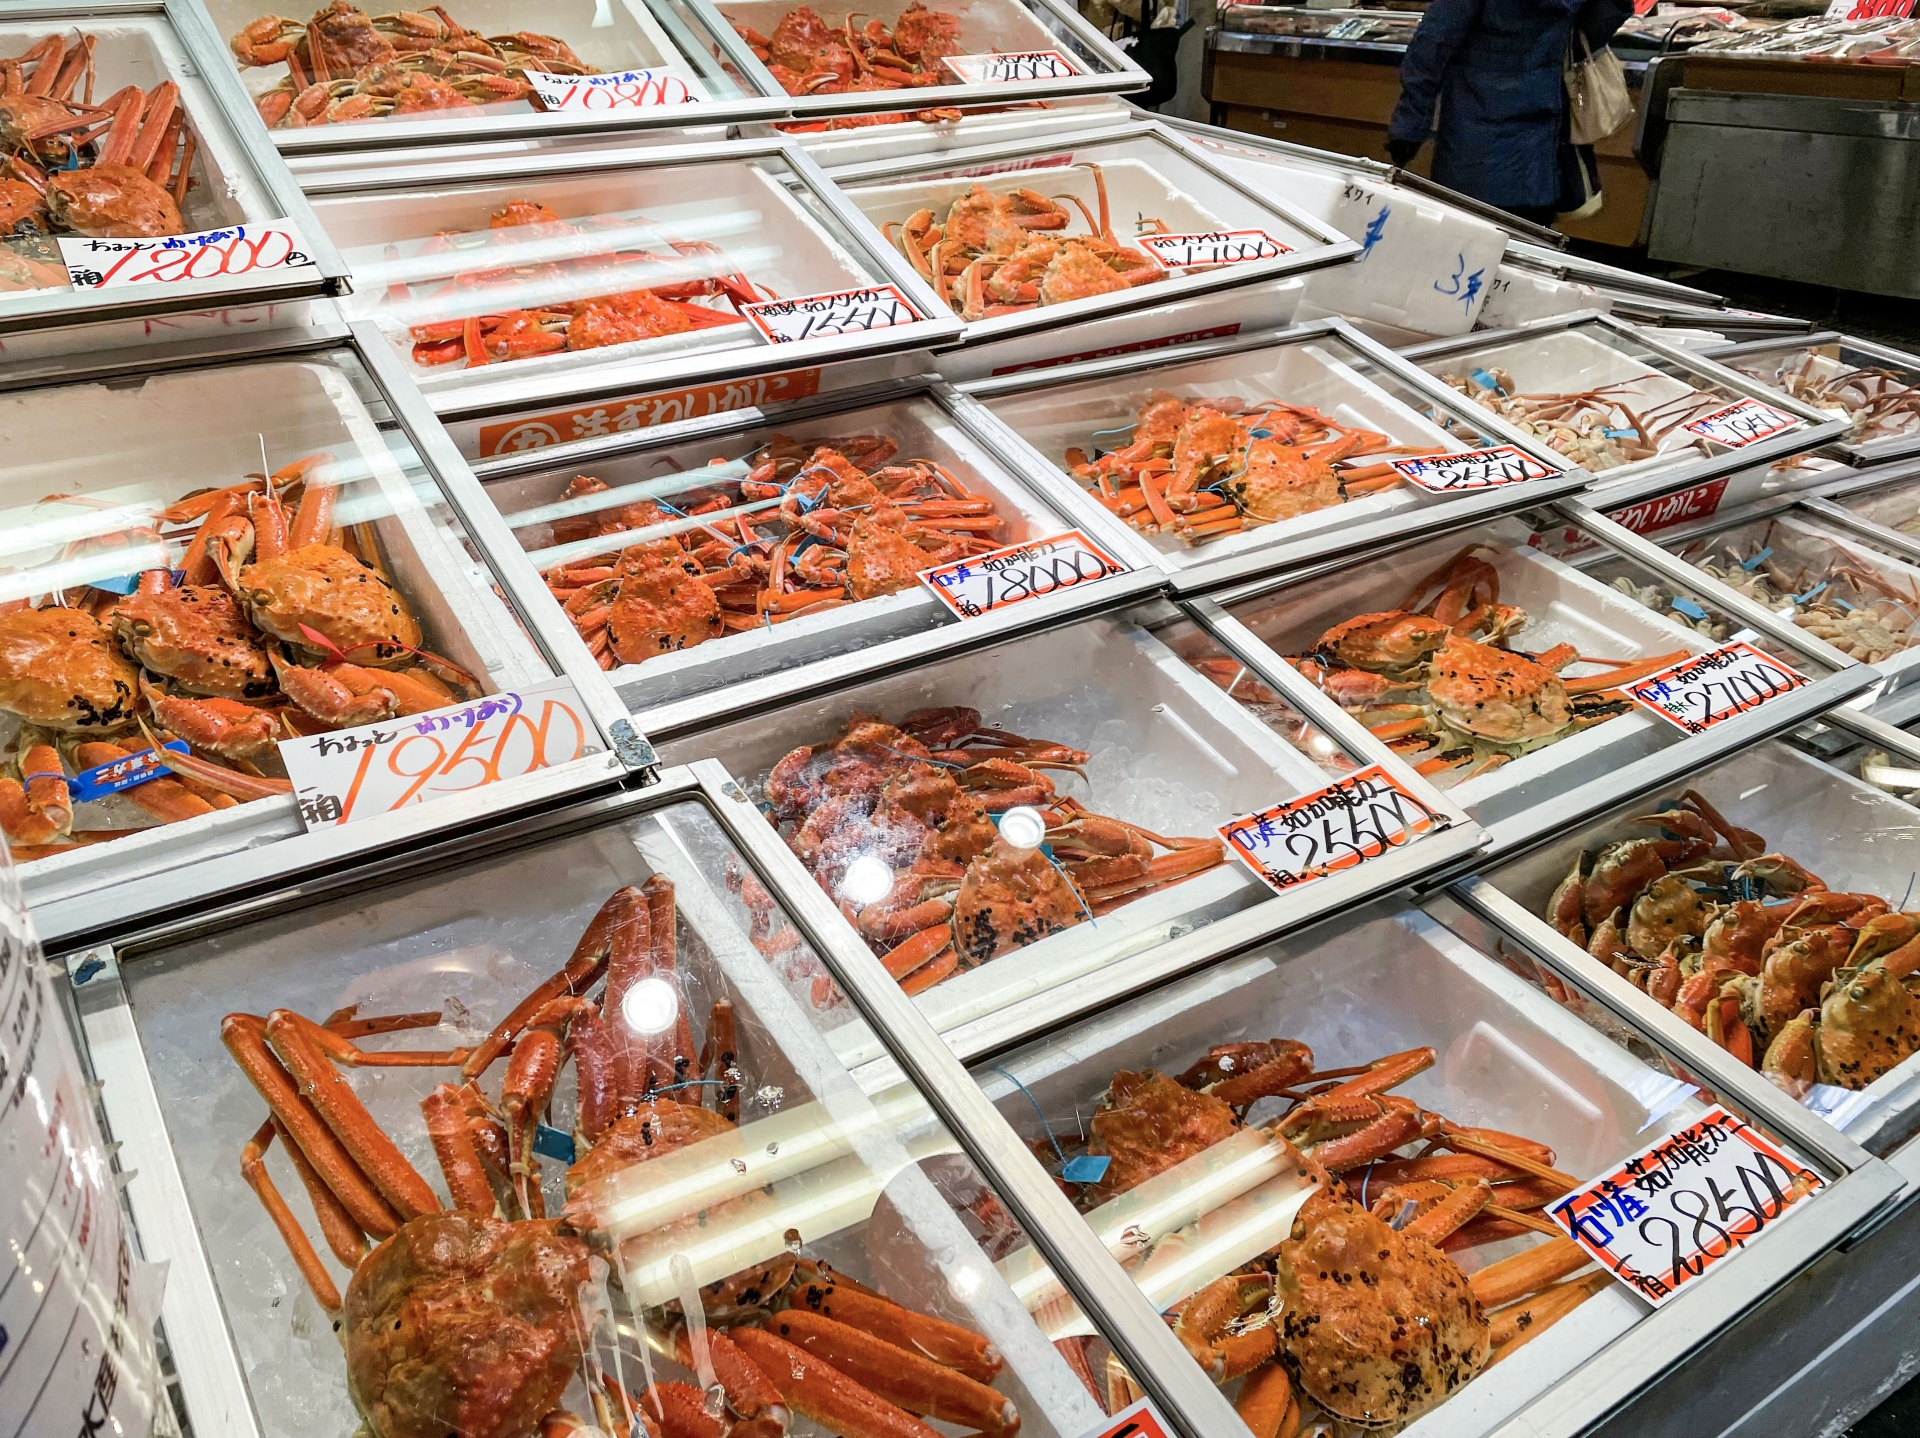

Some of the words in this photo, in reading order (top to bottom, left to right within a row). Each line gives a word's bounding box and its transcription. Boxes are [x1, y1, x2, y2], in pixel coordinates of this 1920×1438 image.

[1493, 278, 1511, 293] ワイ
[1611, 488, 1708, 530] わいがに
[414, 692, 522, 735] わけあり
[1552, 1180, 1649, 1248] 石川産
